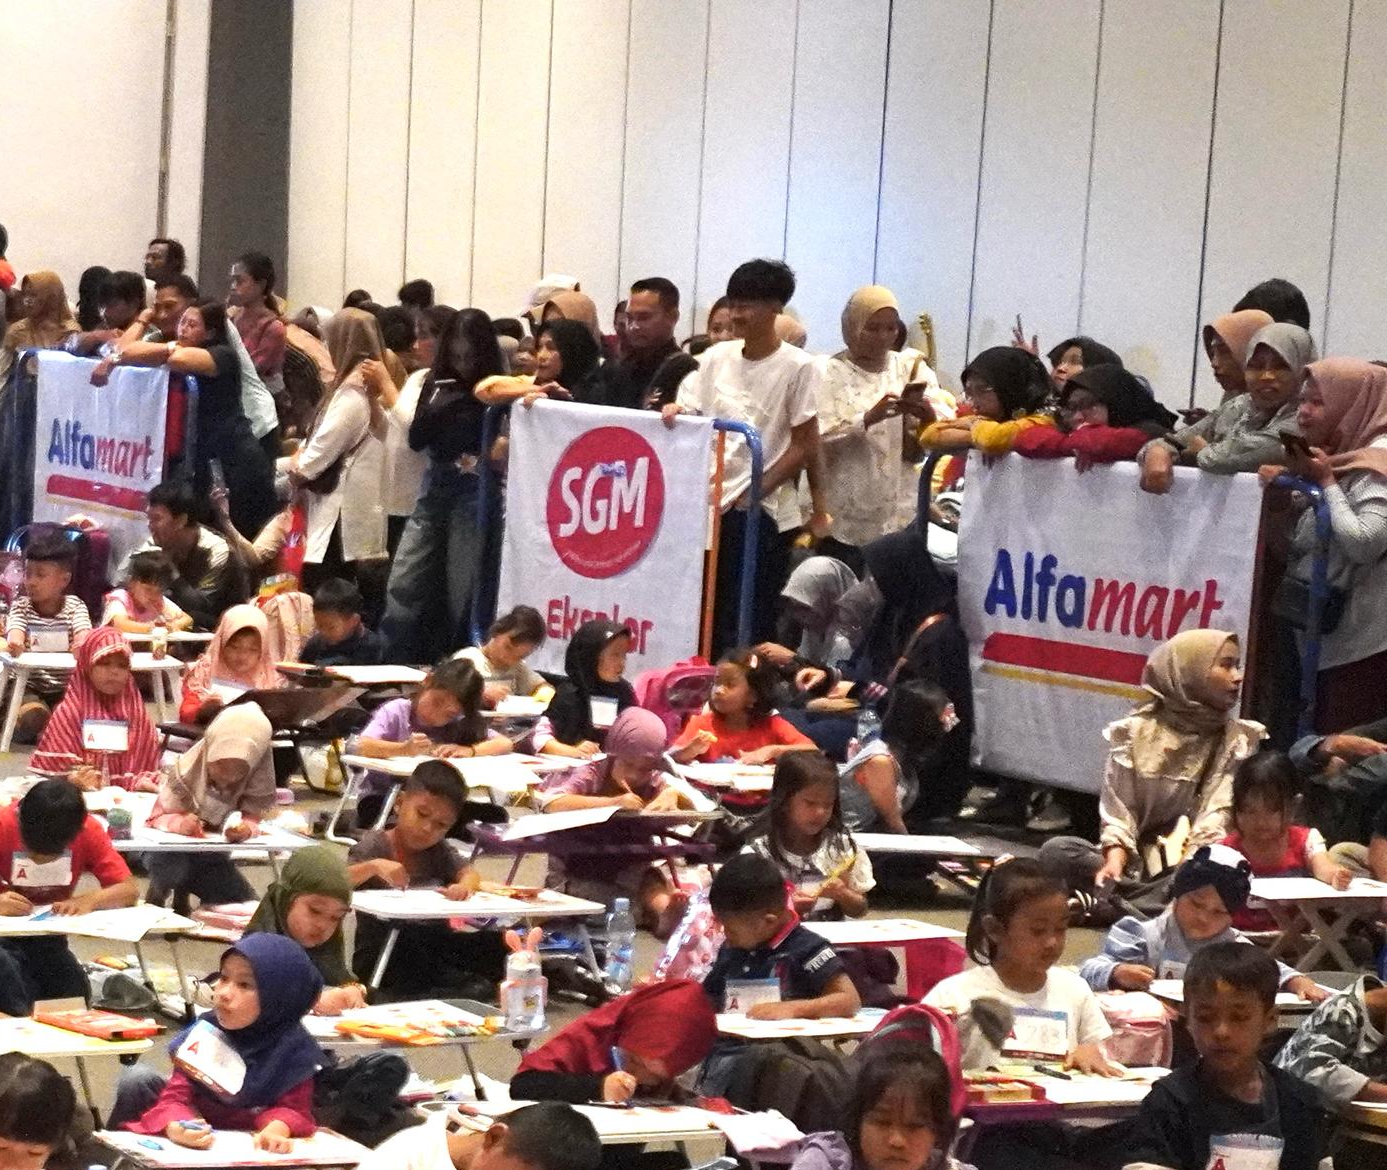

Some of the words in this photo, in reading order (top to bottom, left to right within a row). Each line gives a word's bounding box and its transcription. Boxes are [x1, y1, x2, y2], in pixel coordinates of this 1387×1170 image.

[48, 417, 155, 480] Alfamart
[558, 456, 650, 538] SGM
[984, 548, 1225, 640] Alfamart
[16, 867, 27, 879] A
[729, 998, 739, 1010] A
[187, 1041, 201, 1055] A
